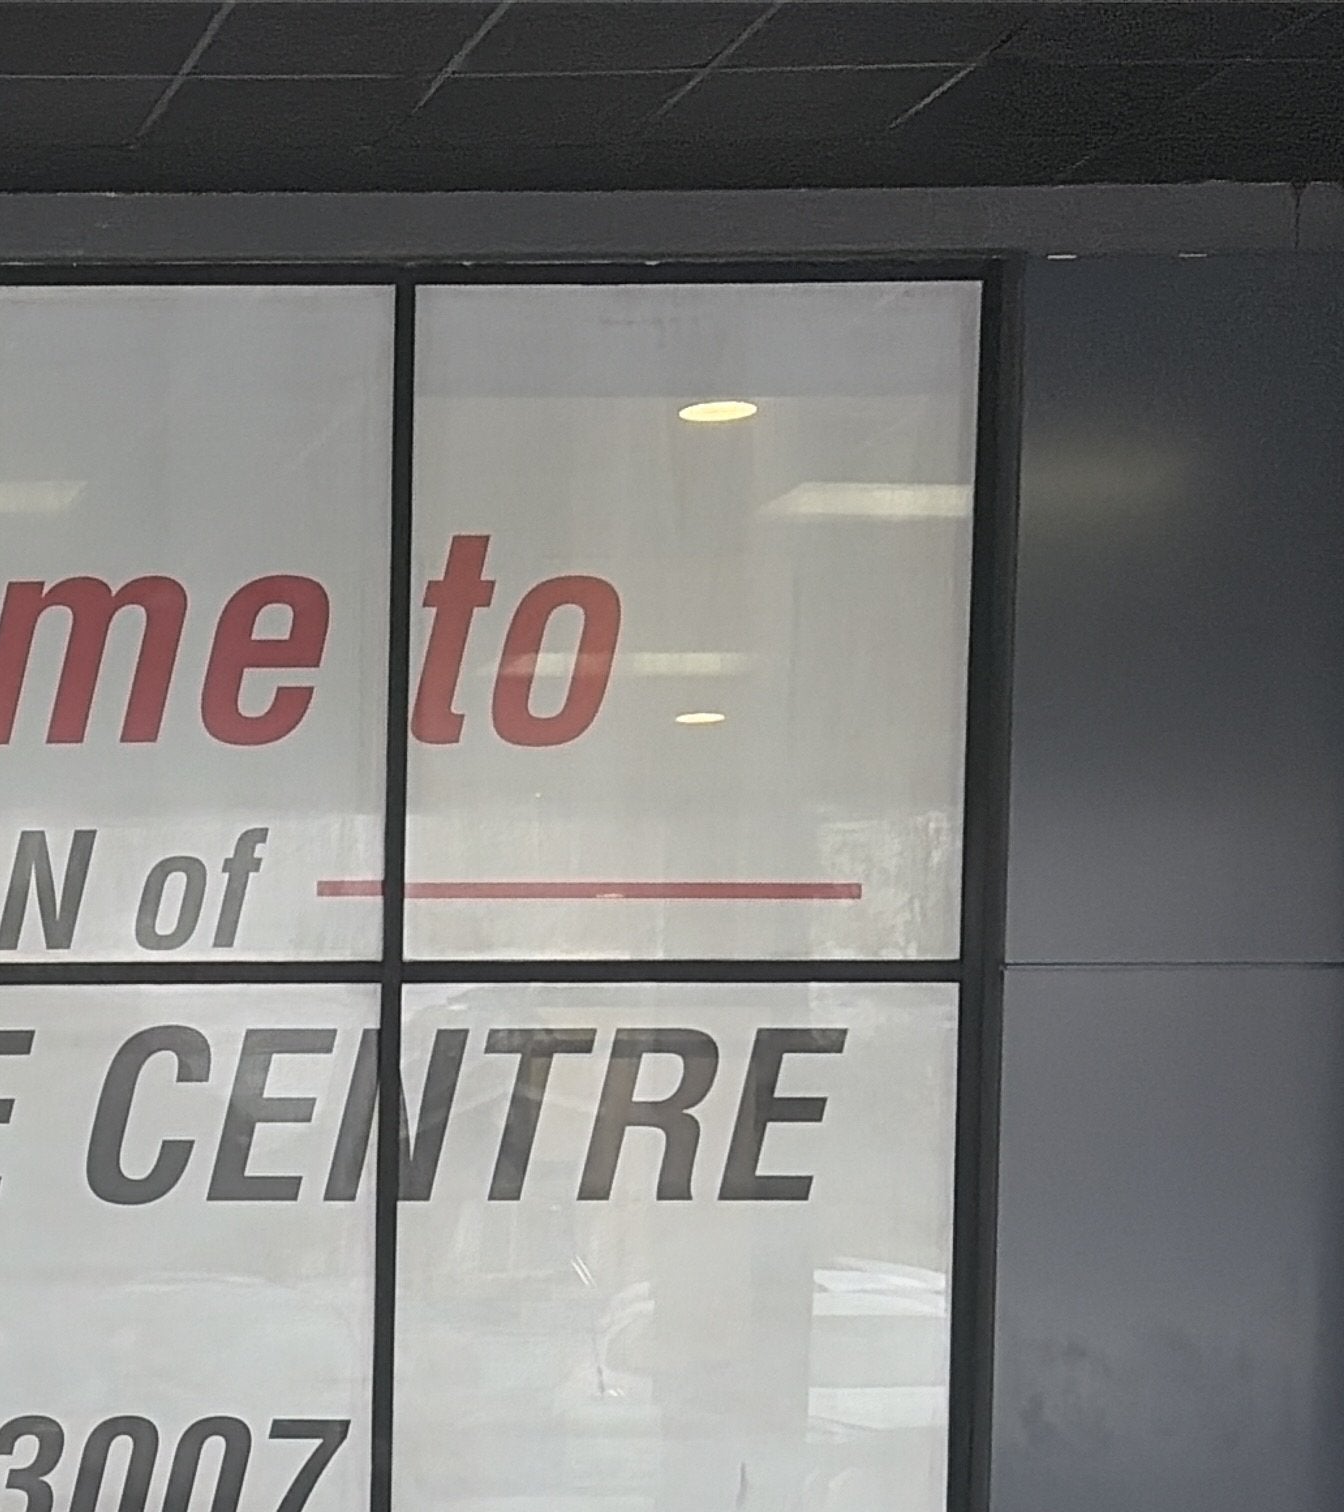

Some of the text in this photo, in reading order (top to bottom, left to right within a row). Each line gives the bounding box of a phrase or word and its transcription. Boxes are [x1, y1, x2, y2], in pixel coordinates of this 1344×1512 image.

[410, 534, 622, 748] to
[134, 827, 270, 951] of
[85, 1024, 849, 1206] CENTRE
